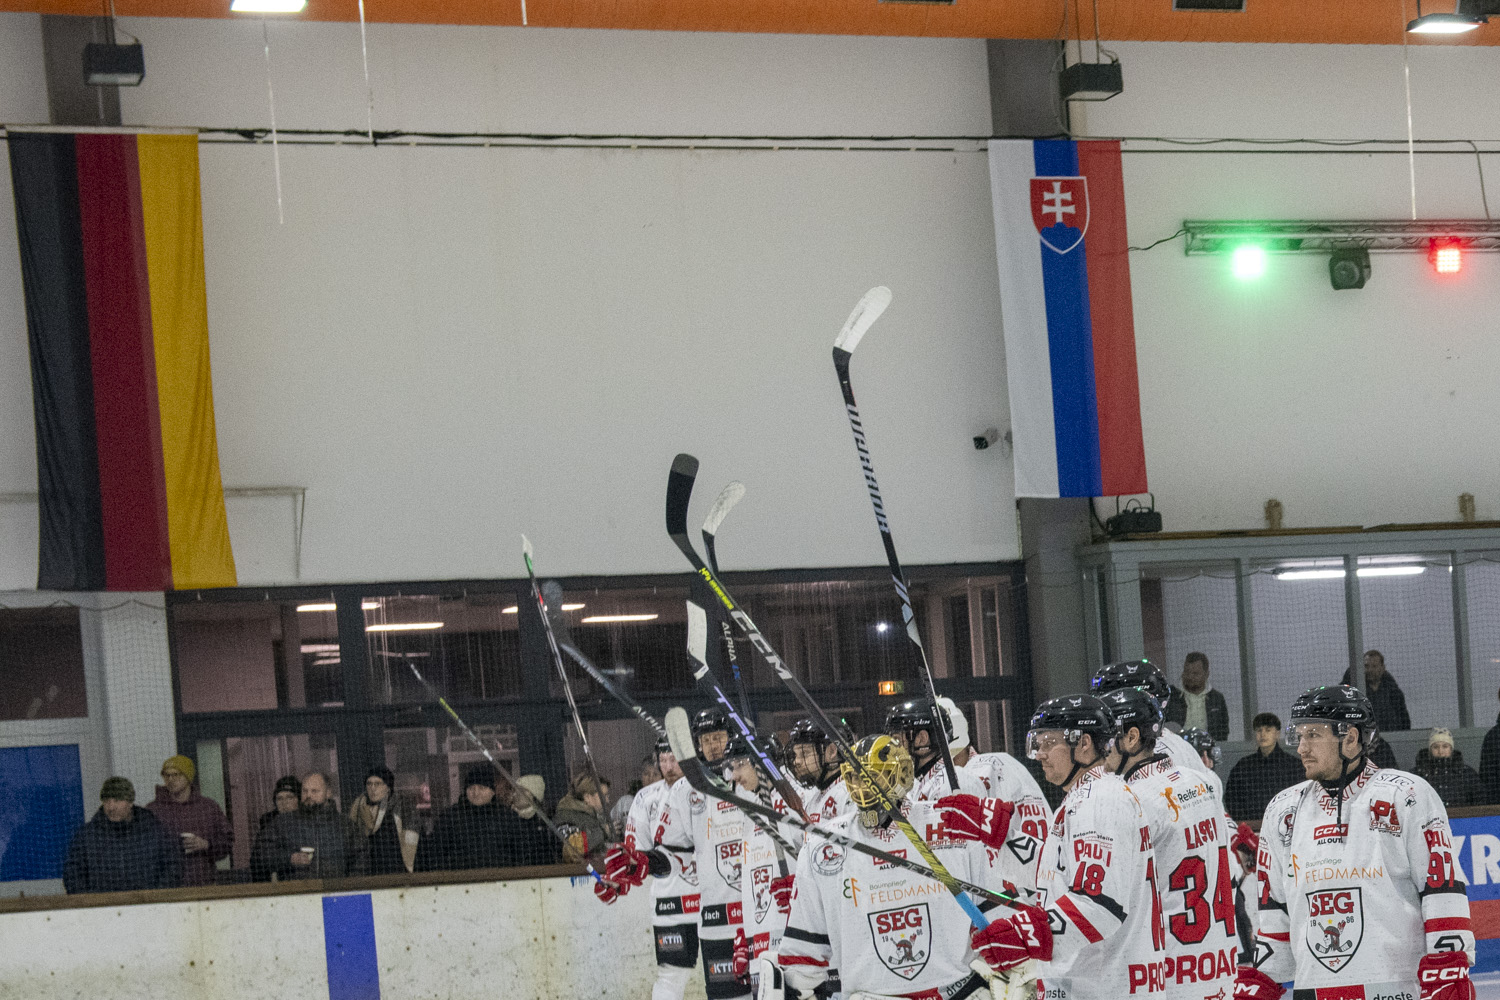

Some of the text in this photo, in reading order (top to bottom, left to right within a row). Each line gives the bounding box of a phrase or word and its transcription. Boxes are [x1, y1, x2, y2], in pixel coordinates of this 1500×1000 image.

[731, 610, 793, 680] CCM
[713, 685, 785, 782] TRUE
[859, 768, 893, 812] TACKS
[1022, 819, 1048, 842] 91
[1315, 824, 1348, 837] CCM
[1305, 857, 1342, 868] Baumpflege
[1305, 866, 1384, 884] FELDMANN
[869, 879, 907, 891] Baumpflege
[1072, 861, 1107, 896] 18
[658, 901, 676, 911] dach
[1169, 845, 1236, 945] 34
[1310, 892, 1355, 917] SEG
[876, 908, 923, 935] SEG
